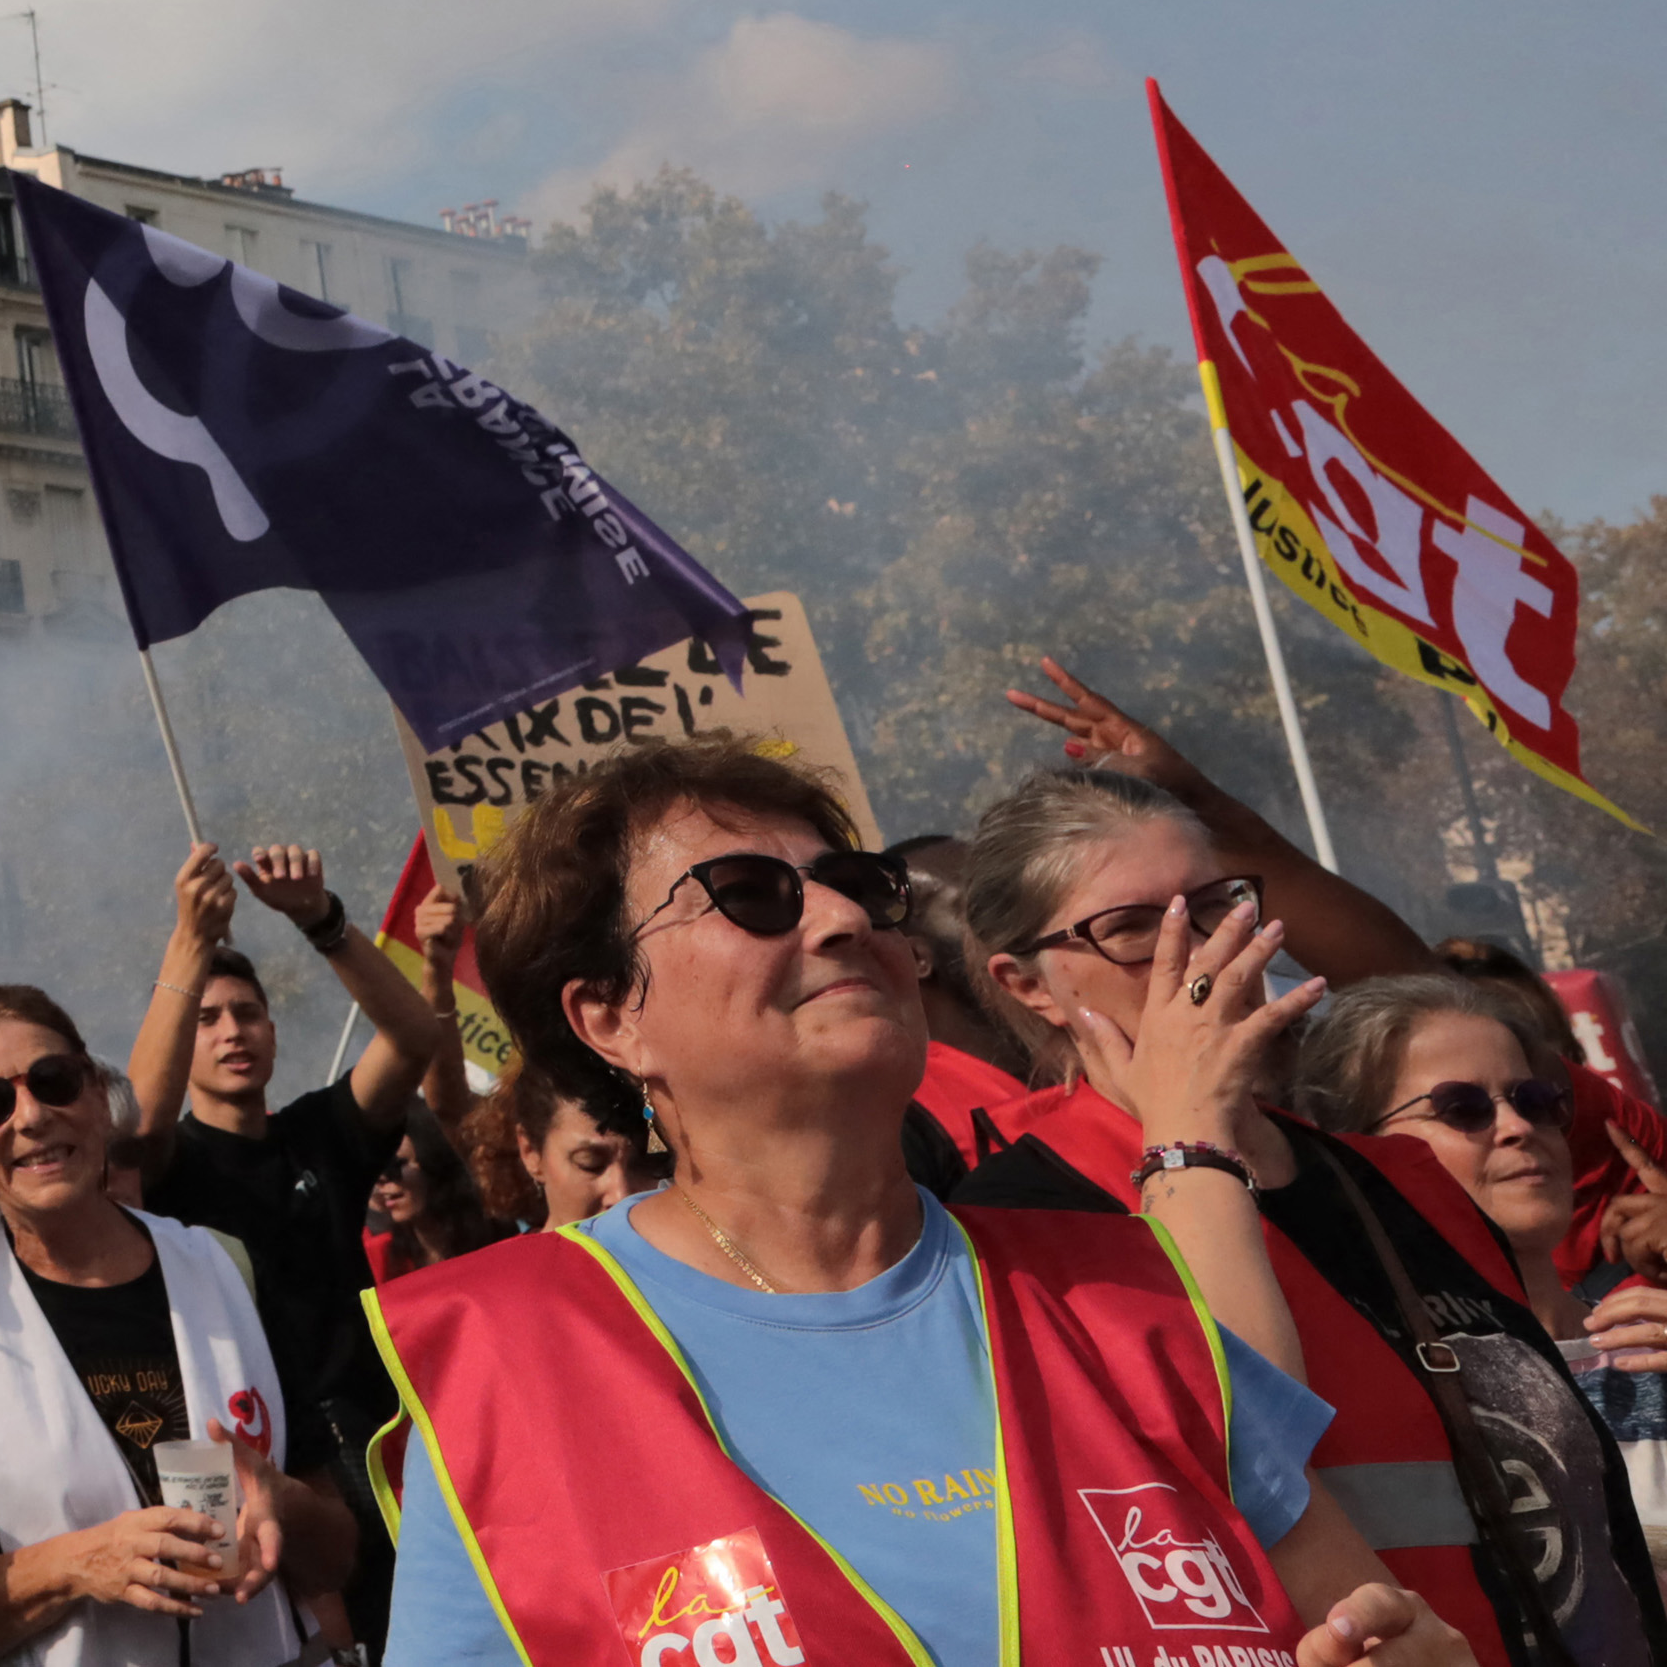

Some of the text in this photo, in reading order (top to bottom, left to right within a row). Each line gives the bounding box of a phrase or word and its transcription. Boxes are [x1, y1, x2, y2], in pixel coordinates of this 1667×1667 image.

[86, 1370, 169, 1397] UCKY DAY
[856, 1468, 997, 1507] NO RAIN
[922, 1499, 995, 1522] flowers
[1117, 1505, 1207, 1552] la
[1121, 1538, 1251, 1619] cgt
[637, 1566, 775, 1639] la
